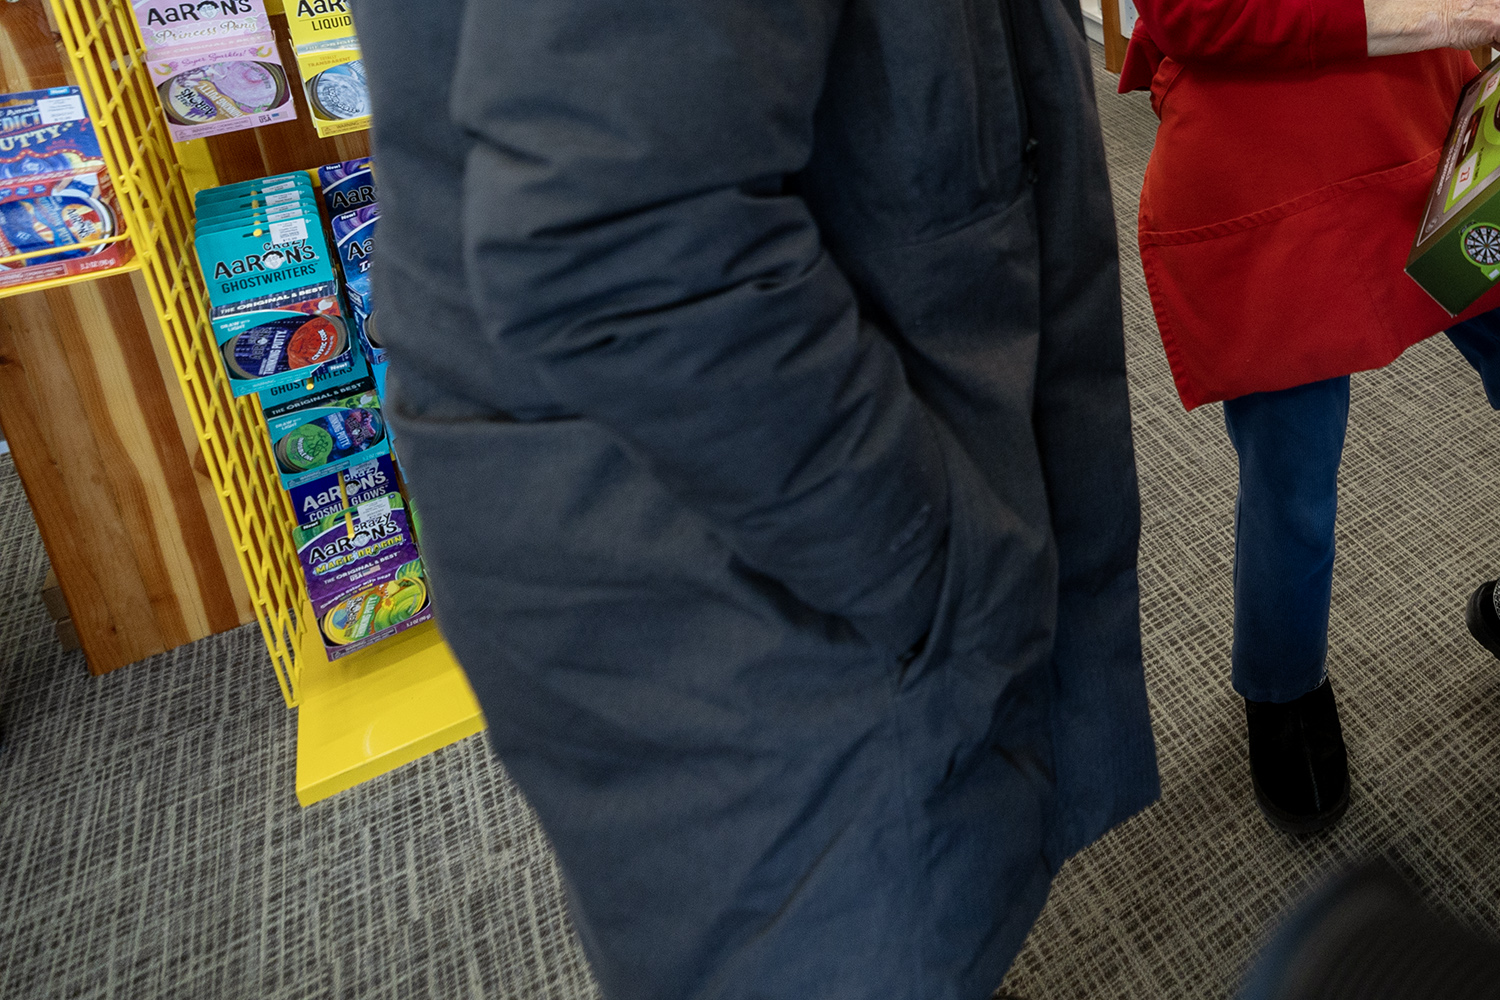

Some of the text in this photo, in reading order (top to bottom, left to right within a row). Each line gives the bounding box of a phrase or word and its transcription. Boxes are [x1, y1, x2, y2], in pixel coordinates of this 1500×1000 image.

[312, 15, 352, 31] LIQUID
[155, 20, 257, 41] Princess Pony
[208, 50, 247, 62] Sparkles!
[307, 56, 351, 67] TRANSPARENT
[341, 212, 356, 221] New!
[221, 263, 316, 294] GHOSTWRITERS
[220, 307, 235, 315] THE
[236, 293, 291, 311] ORIGINAL
[299, 286, 323, 297] BEST
[220, 321, 239, 330] DRAW
[227, 324, 246, 332] LIGHT
[330, 363, 349, 371] New!
[270, 367, 353, 397] GHOSTRITERS
[272, 408, 286, 416] THE
[286, 392, 333, 410] ORIGINAL
[340, 383, 362, 394] BEST
[275, 420, 293, 429] DRAW
[281, 422, 297, 431] LIGHT
[309, 486, 387, 522] COSMI GLOWS
[303, 521, 319, 530] New!
[315, 535, 403, 575] MAGIC DRAGON
[336, 562, 375, 580] ORIGINAL
[380, 552, 398, 562] BEST
[350, 573, 364, 582] USA
